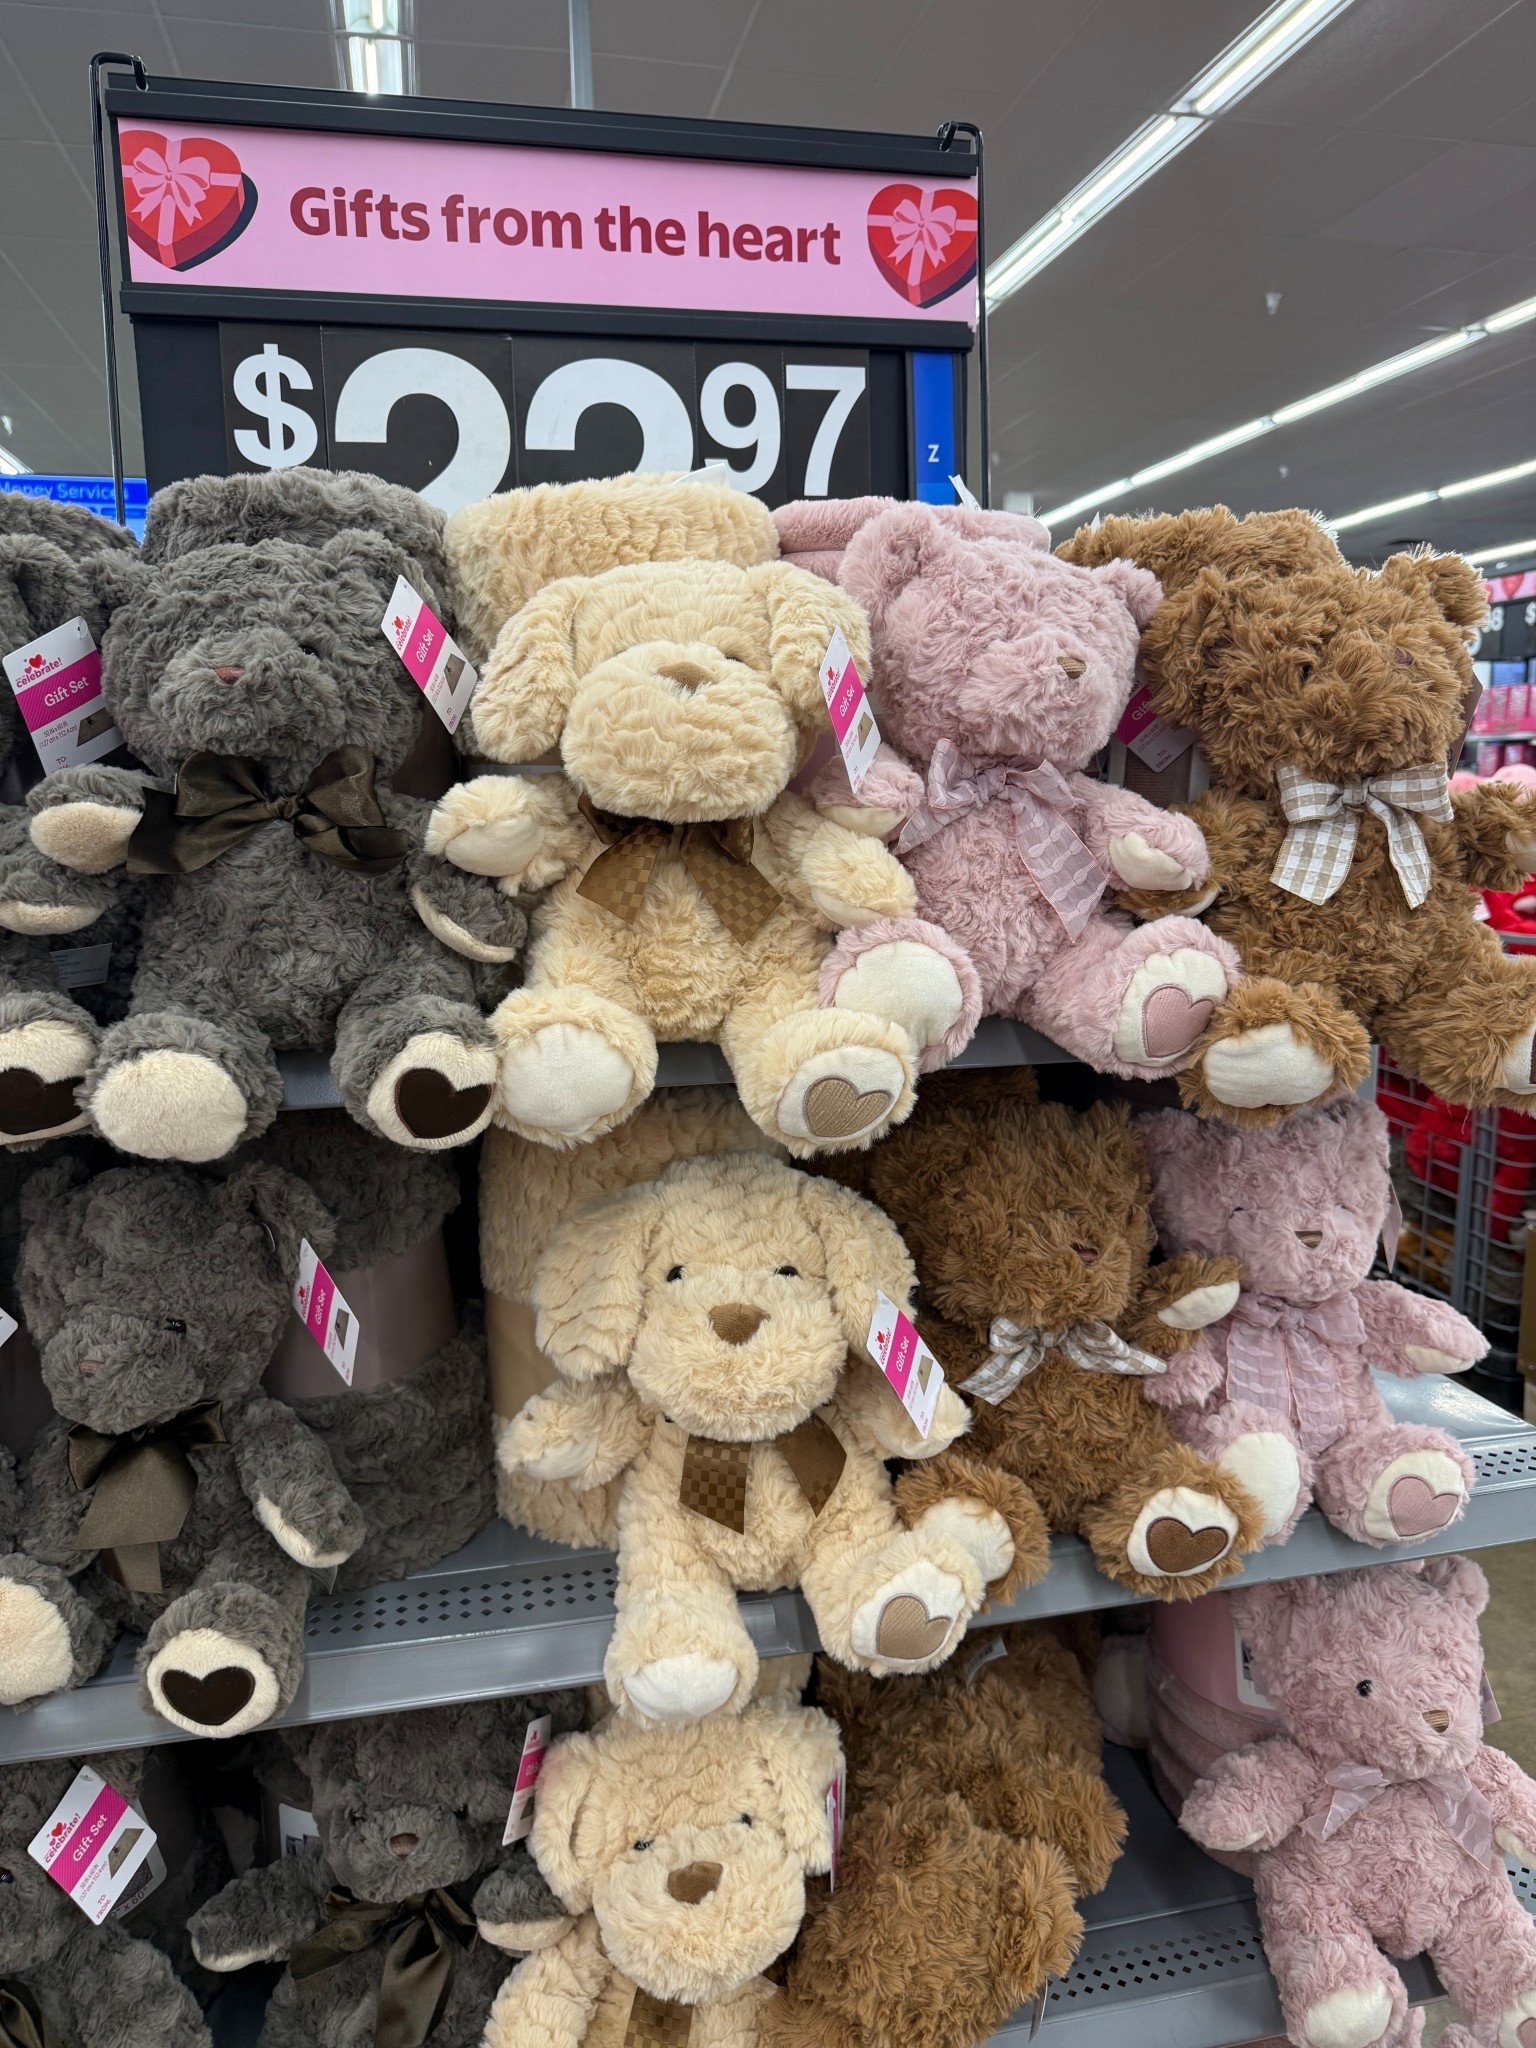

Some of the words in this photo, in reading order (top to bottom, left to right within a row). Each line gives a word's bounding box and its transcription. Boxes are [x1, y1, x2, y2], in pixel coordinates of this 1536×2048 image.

[289, 186, 430, 241] Gifts
[441, 194, 583, 249] from
[594, 205, 686, 256] the
[698, 211, 841, 265] heart
[928, 444, 940, 462] Z
[416, 641, 429, 663] Gift
[423, 628, 435, 646] Set
[16, 657, 63, 688] celebrate!
[44, 687, 69, 707] Gift
[69, 676, 89, 694] Set
[1131, 700, 1150, 721] Gif
[314, 1304, 323, 1325] Gift
[900, 1335, 910, 1354] Set
[895, 1351, 906, 1373] Gift
[45, 1812, 81, 1863] celebrate!
[73, 1834, 94, 1862] Gift
[90, 1813, 108, 1837] Set
